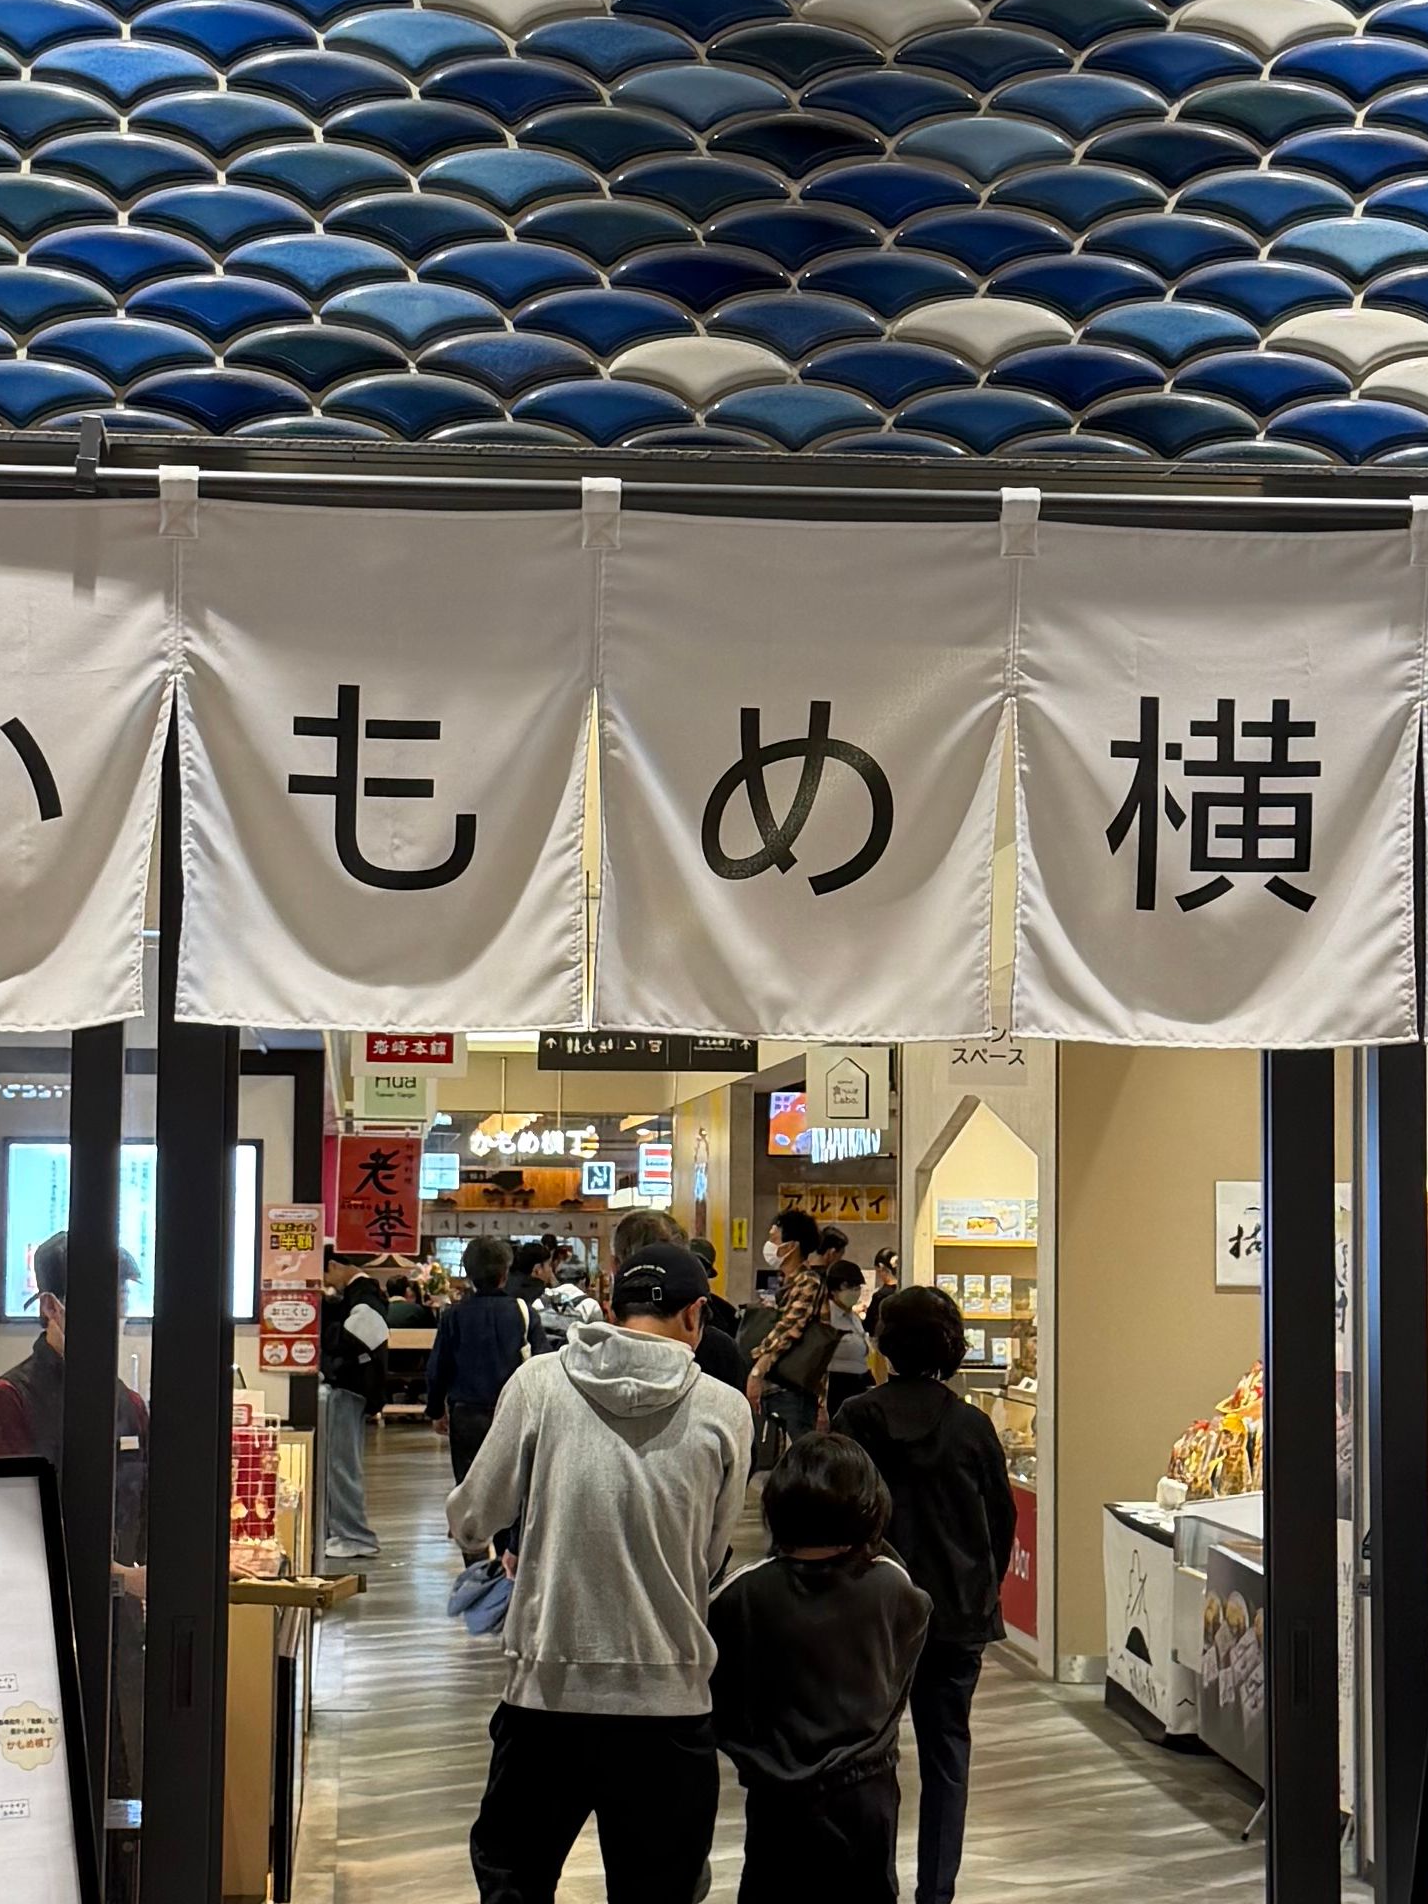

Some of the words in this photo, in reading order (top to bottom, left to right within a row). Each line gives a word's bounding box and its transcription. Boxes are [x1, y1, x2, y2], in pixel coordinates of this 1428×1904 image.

[951, 1048, 1025, 1065] スペース
[7, 1738, 53, 1750] かもめ横丁
